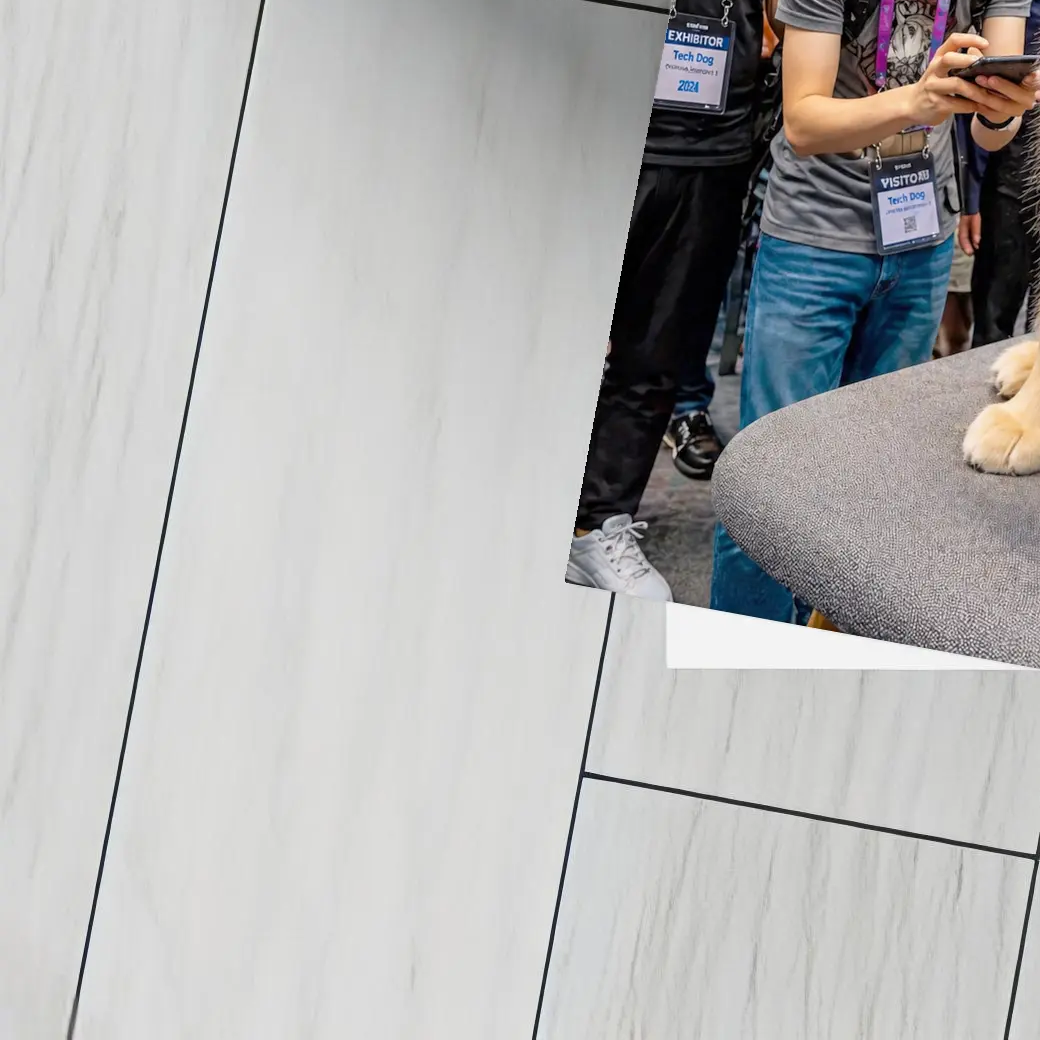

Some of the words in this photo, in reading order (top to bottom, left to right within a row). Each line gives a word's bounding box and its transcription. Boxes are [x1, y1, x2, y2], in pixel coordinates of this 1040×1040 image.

[667, 30, 724, 48] EXHIBITOR
[673, 50, 694, 62] Tech
[696, 53, 714, 66] Dog
[677, 79, 700, 93] 2024
[909, 191, 926, 202] Dog
